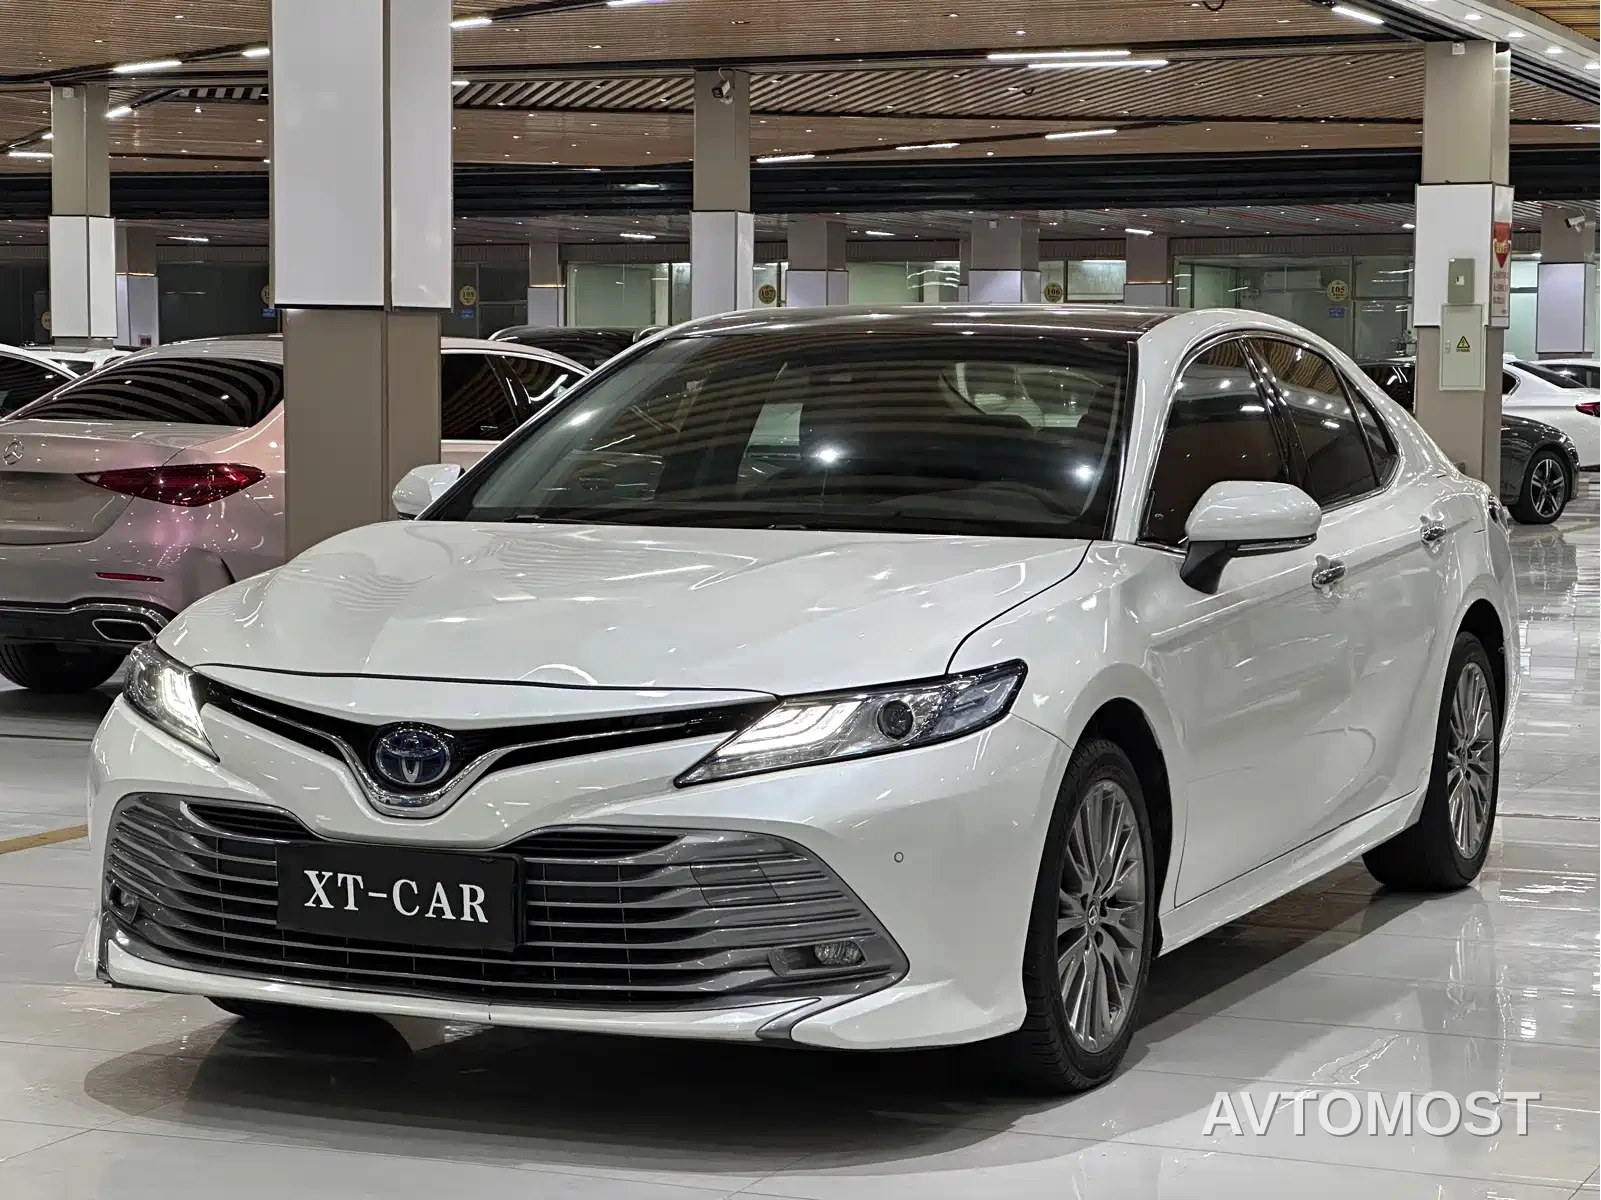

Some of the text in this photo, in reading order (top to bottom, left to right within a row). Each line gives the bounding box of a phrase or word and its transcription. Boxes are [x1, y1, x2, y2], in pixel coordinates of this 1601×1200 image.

[761, 289, 774, 297] 107
[1047, 288, 1061, 296] 106
[304, 869, 489, 923] XT-CAR
